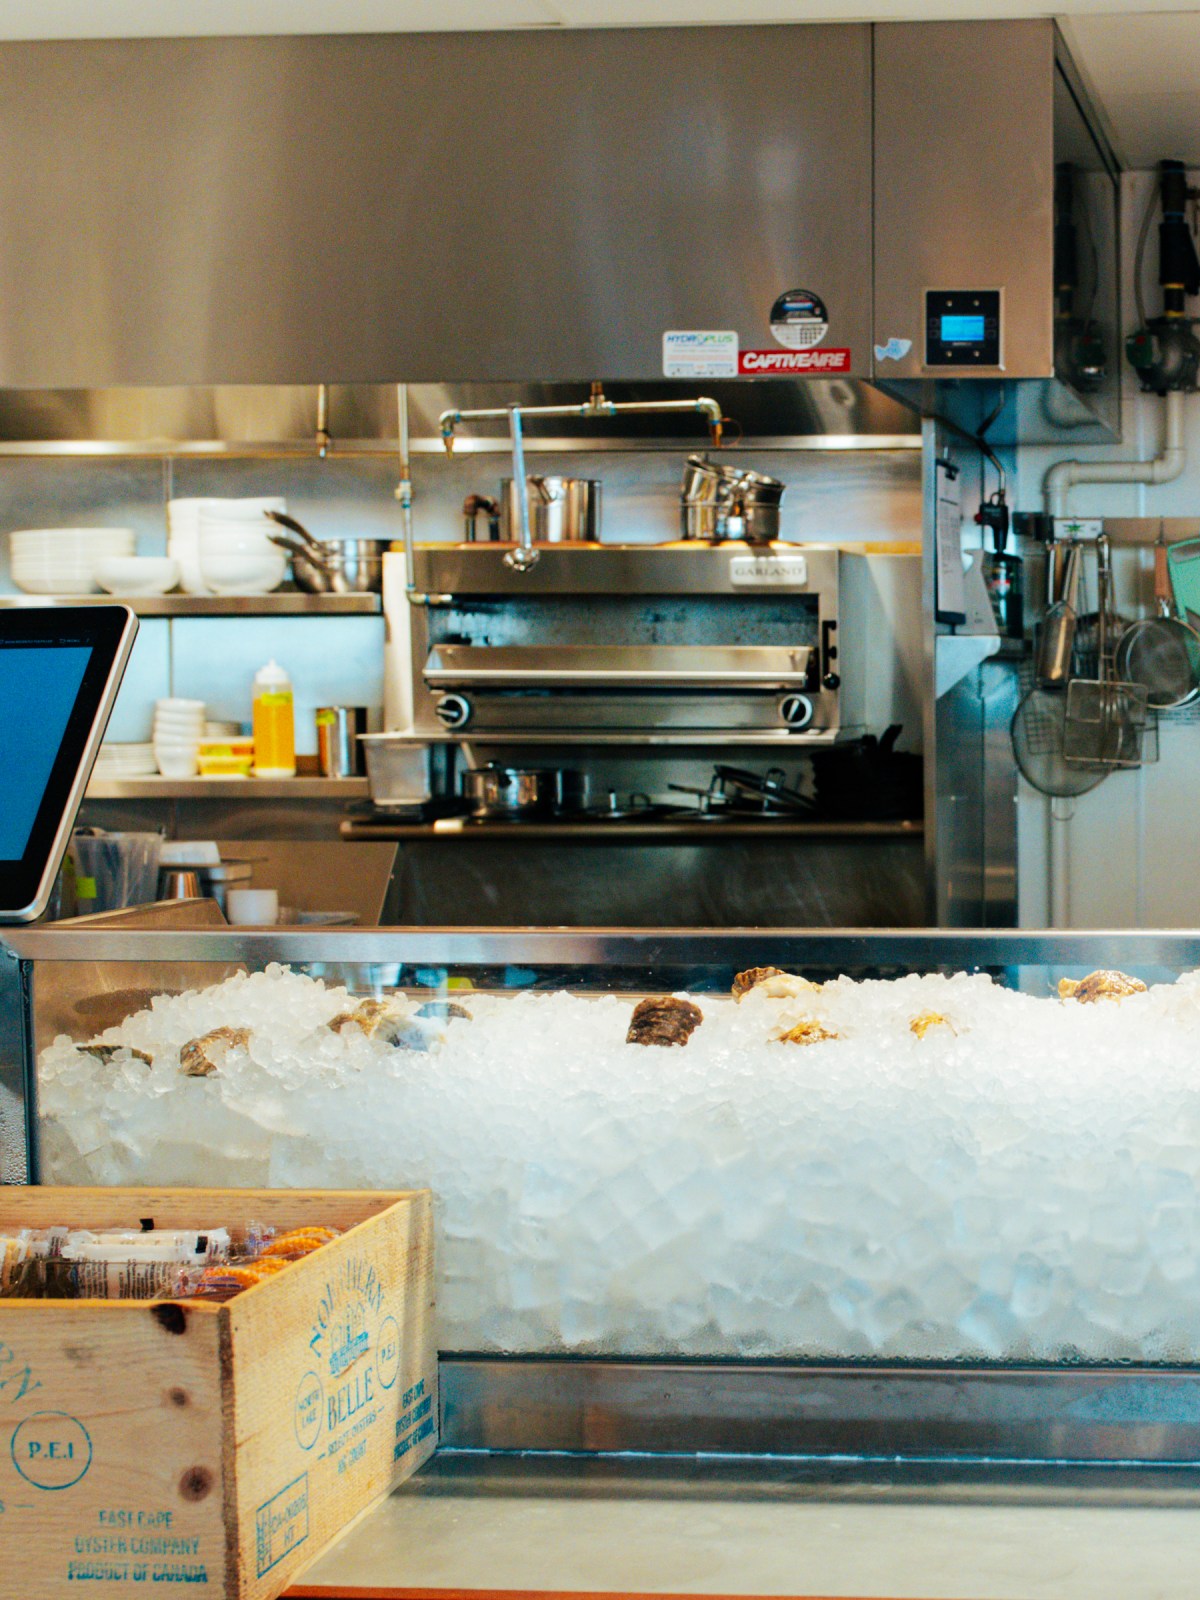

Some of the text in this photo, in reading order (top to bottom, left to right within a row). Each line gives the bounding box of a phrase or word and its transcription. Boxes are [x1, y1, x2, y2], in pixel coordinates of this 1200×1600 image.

[328, 1366, 374, 1432] BELLE
[28, 1441, 74, 1459] P.E.I
[75, 1535, 127, 1554] OYSTER
[68, 1561, 128, 1581] PRODUCT
[133, 1562, 149, 1582] OF
